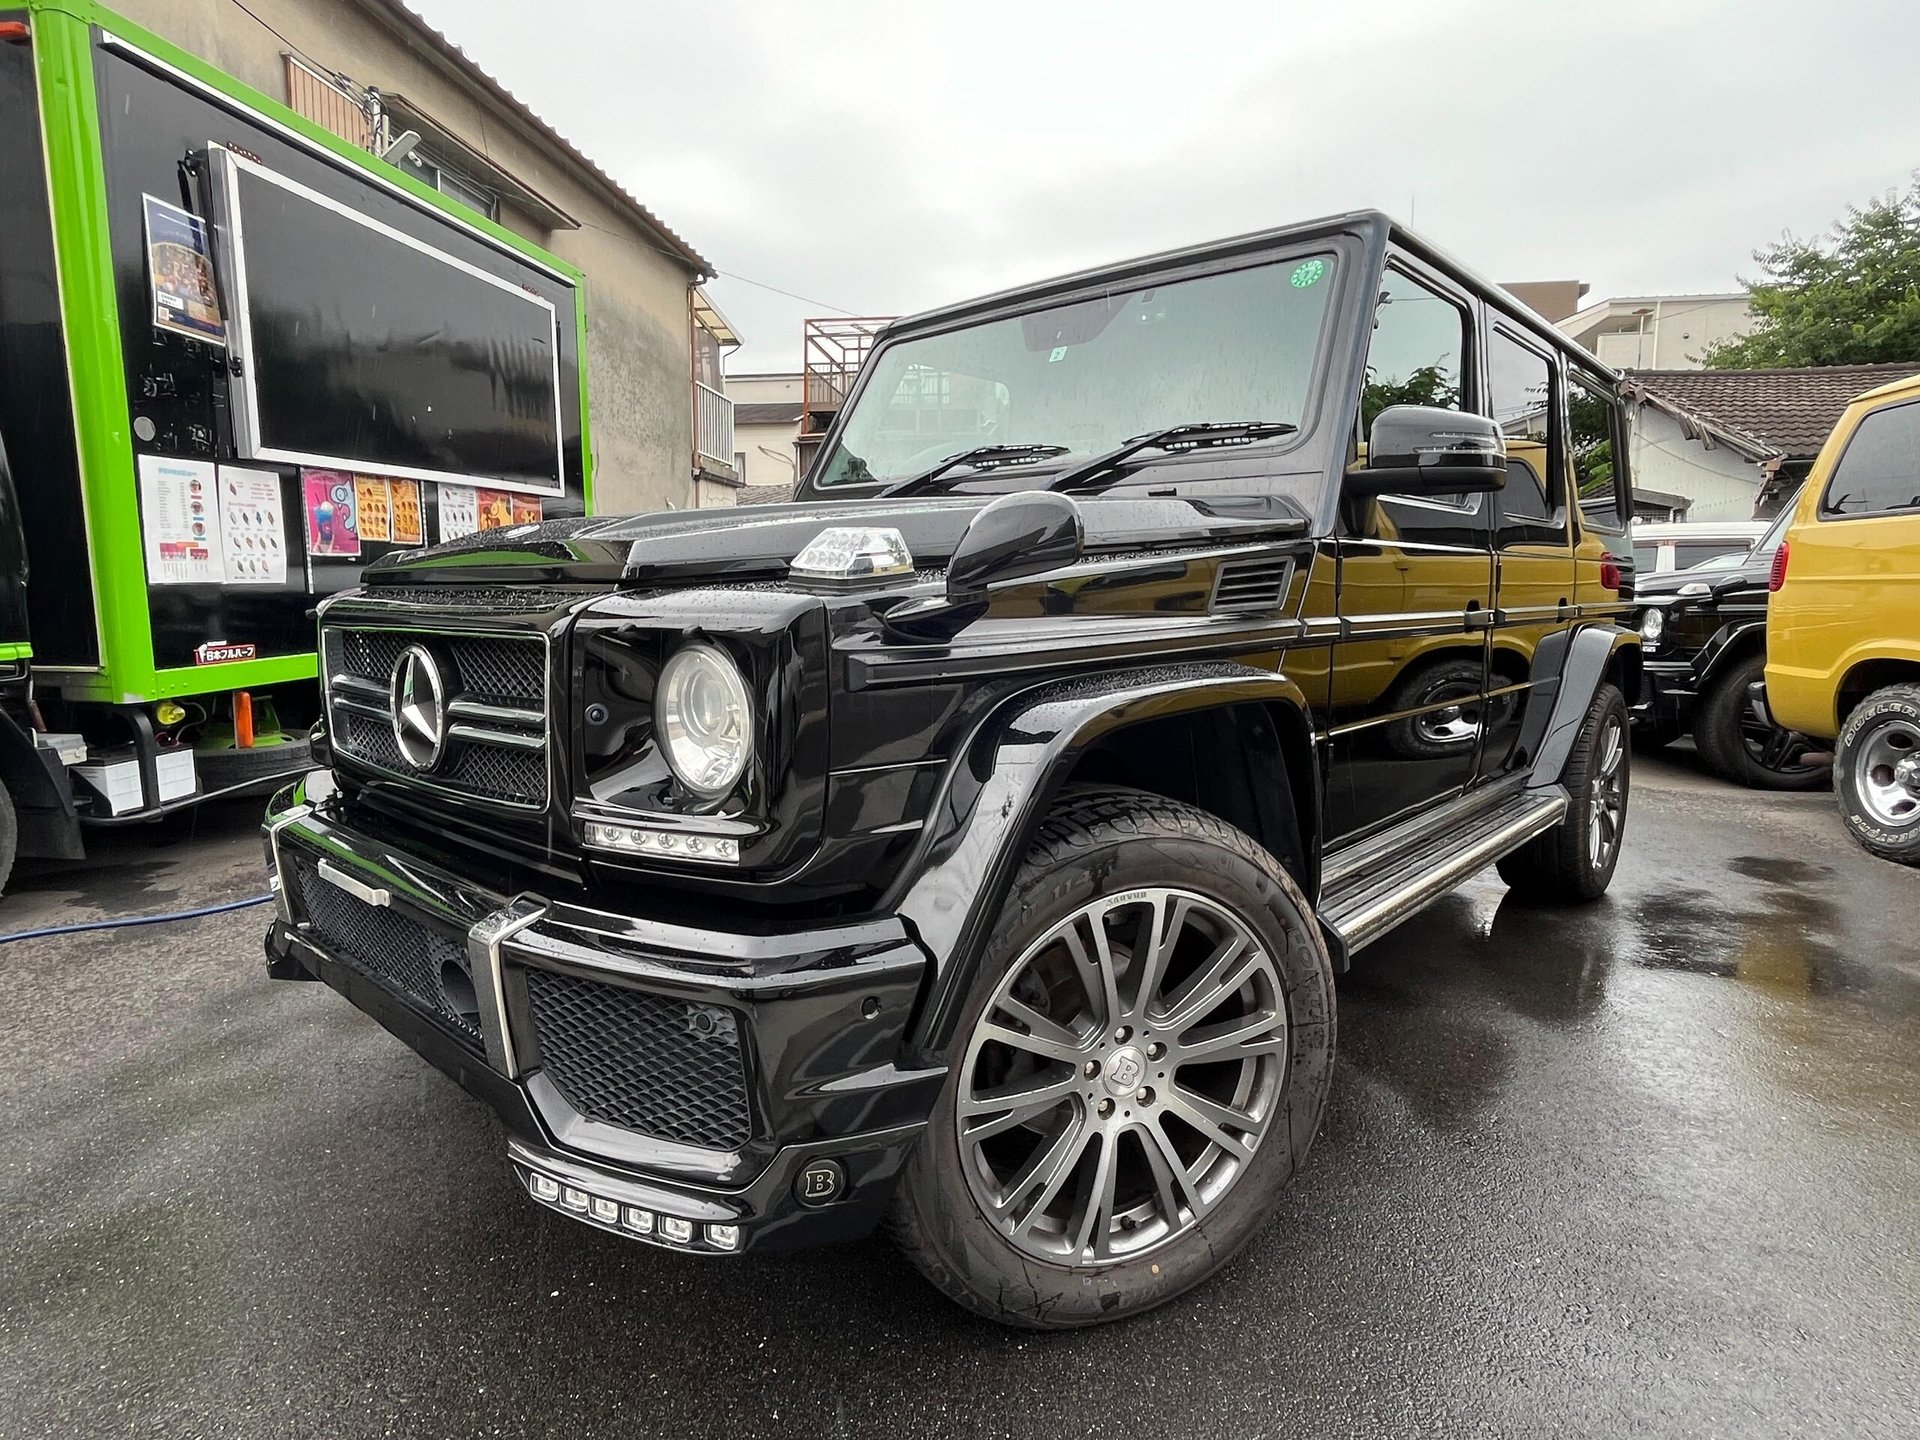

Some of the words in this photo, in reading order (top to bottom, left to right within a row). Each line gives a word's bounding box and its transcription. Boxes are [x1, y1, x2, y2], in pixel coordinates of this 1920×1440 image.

[206, 647, 254, 661] 日本フルハーフ
[1845, 702, 1917, 747] DUELER
[1850, 814, 1920, 844] GESTONE
[1104, 891, 1147, 907] BRABUS
[1109, 1055, 1139, 1088] B
[806, 1169, 835, 1198] B
